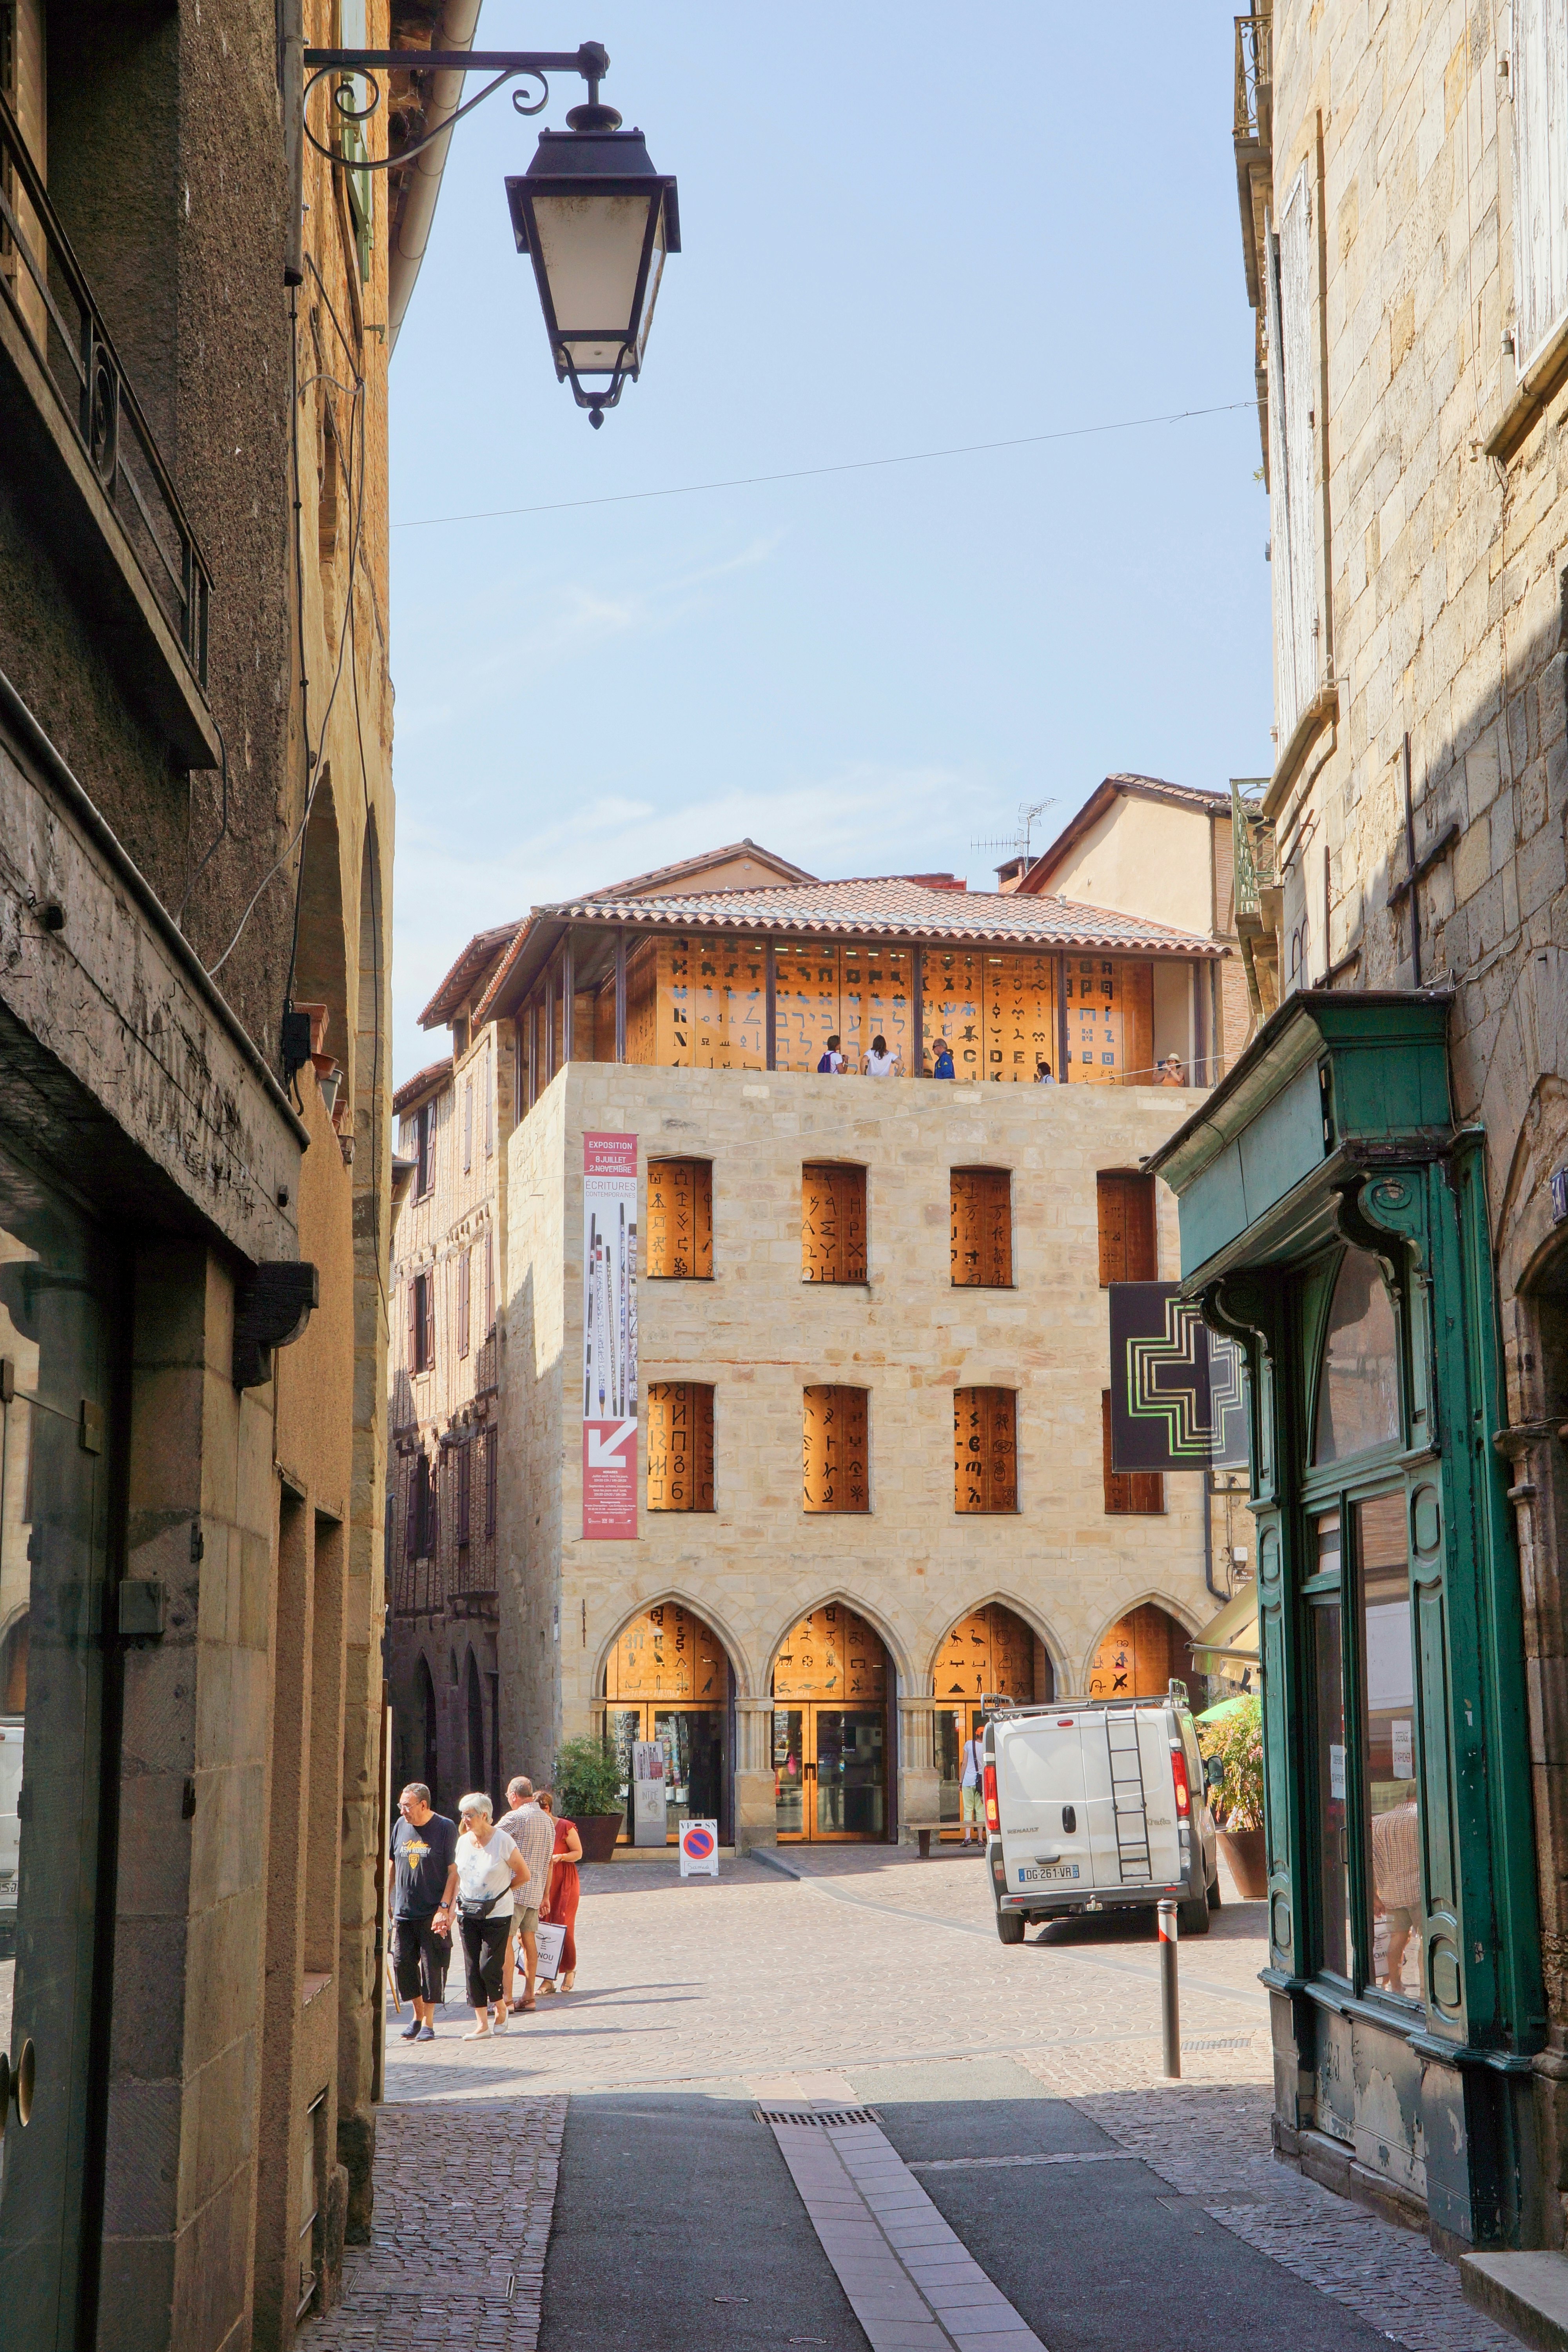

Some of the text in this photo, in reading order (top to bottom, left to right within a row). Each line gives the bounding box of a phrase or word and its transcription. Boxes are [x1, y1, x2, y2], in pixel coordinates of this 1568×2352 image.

[589, 1141, 632, 1149] EXPOSITION
[586, 1179, 635, 1191] ÉCRITURES
[1026, 1867, 1071, 1879] DG-261-VR
